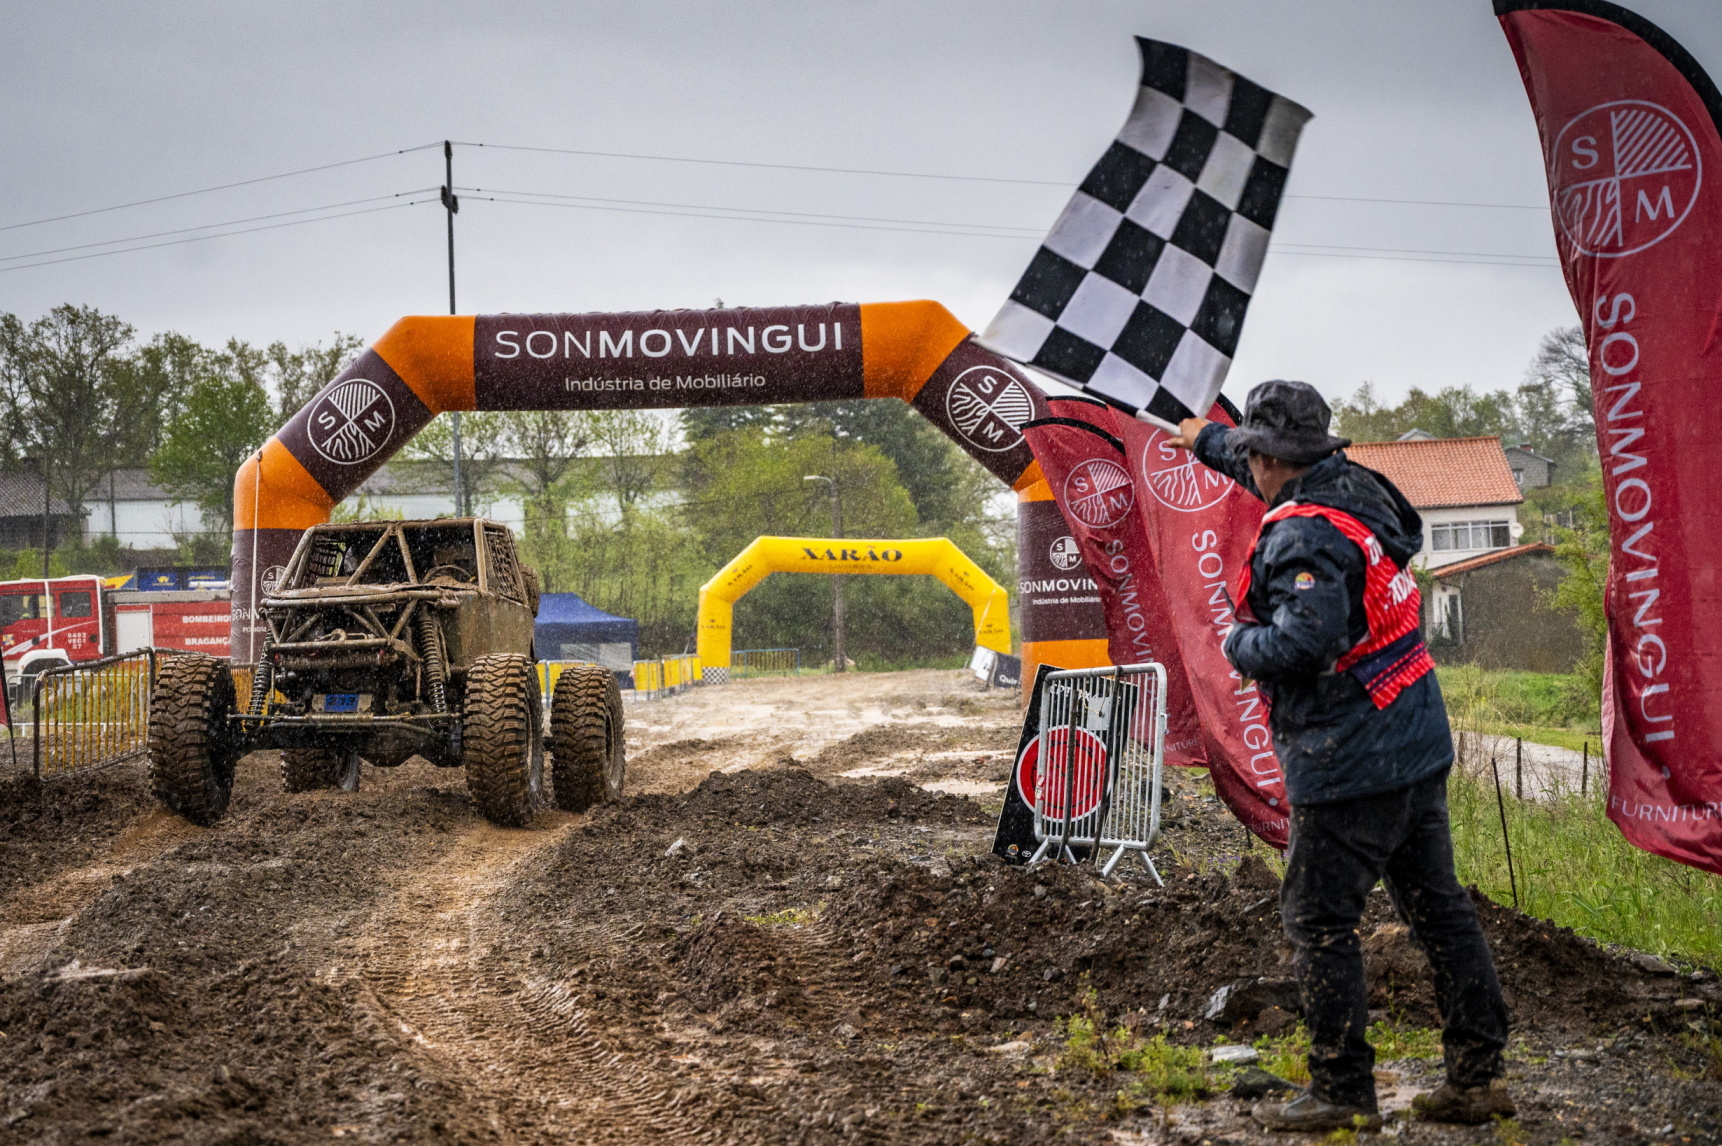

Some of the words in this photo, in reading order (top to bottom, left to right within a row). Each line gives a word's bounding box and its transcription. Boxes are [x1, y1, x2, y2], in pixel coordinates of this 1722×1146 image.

[1571, 136, 1599, 170] S
[1635, 186, 1675, 223] M
[494, 321, 843, 360] SONMOVINGUI
[565, 376, 645, 392] Indústria
[649, 376, 672, 391] de
[676, 372, 766, 390] Mobiliário
[977, 375, 998, 394] S
[318, 410, 336, 430] S
[364, 410, 387, 433] M
[984, 421, 1004, 442] M
[1159, 440, 1177, 461] S
[1075, 477, 1090, 493] S
[1110, 493, 1129, 510] M
[1595, 292, 1675, 743] SONMOVINGUI
[801, 546, 903, 562] XARÃO
[1192, 530, 1281, 787] SONMINGUI
